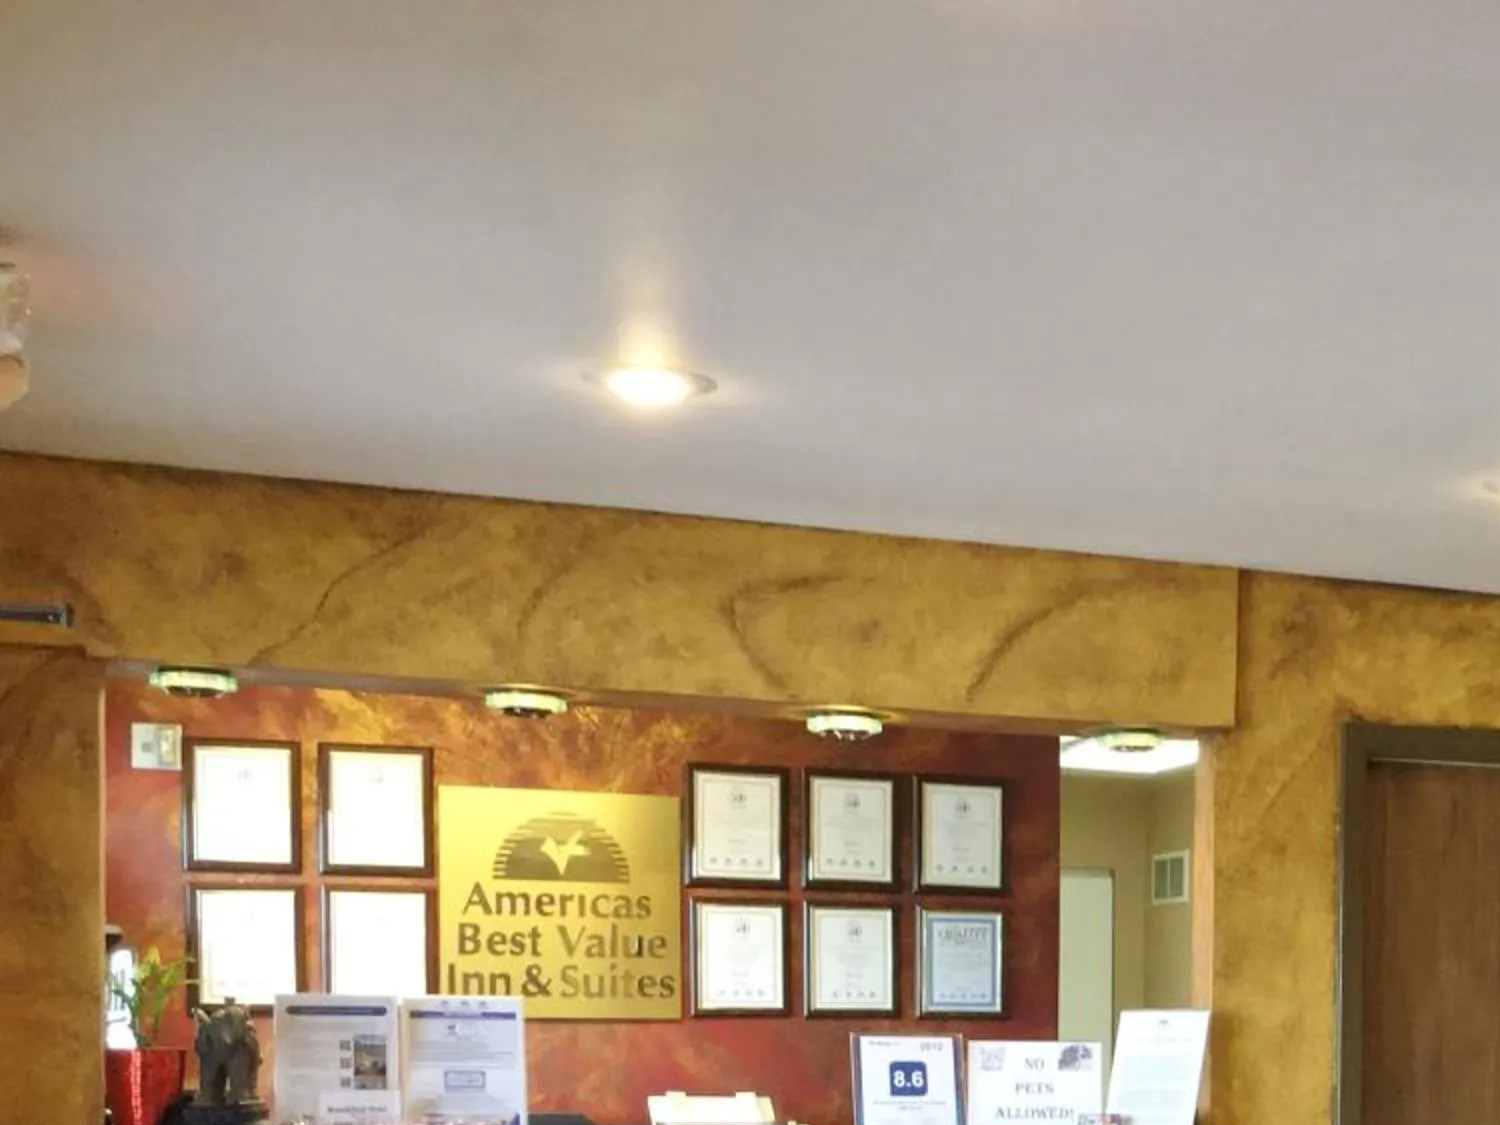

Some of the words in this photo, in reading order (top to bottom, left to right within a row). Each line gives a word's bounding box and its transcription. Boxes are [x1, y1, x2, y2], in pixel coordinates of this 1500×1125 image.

[463, 881, 652, 918] Americas
[458, 922, 542, 956] Best
[557, 924, 668, 958] Value
[447, 962, 511, 995] Inn
[521, 964, 552, 997] &
[559, 964, 676, 999] Suites
[1024, 1056, 1045, 1070] NO
[893, 1070, 924, 1088] 8.6
[1014, 1082, 1054, 1095] PETS
